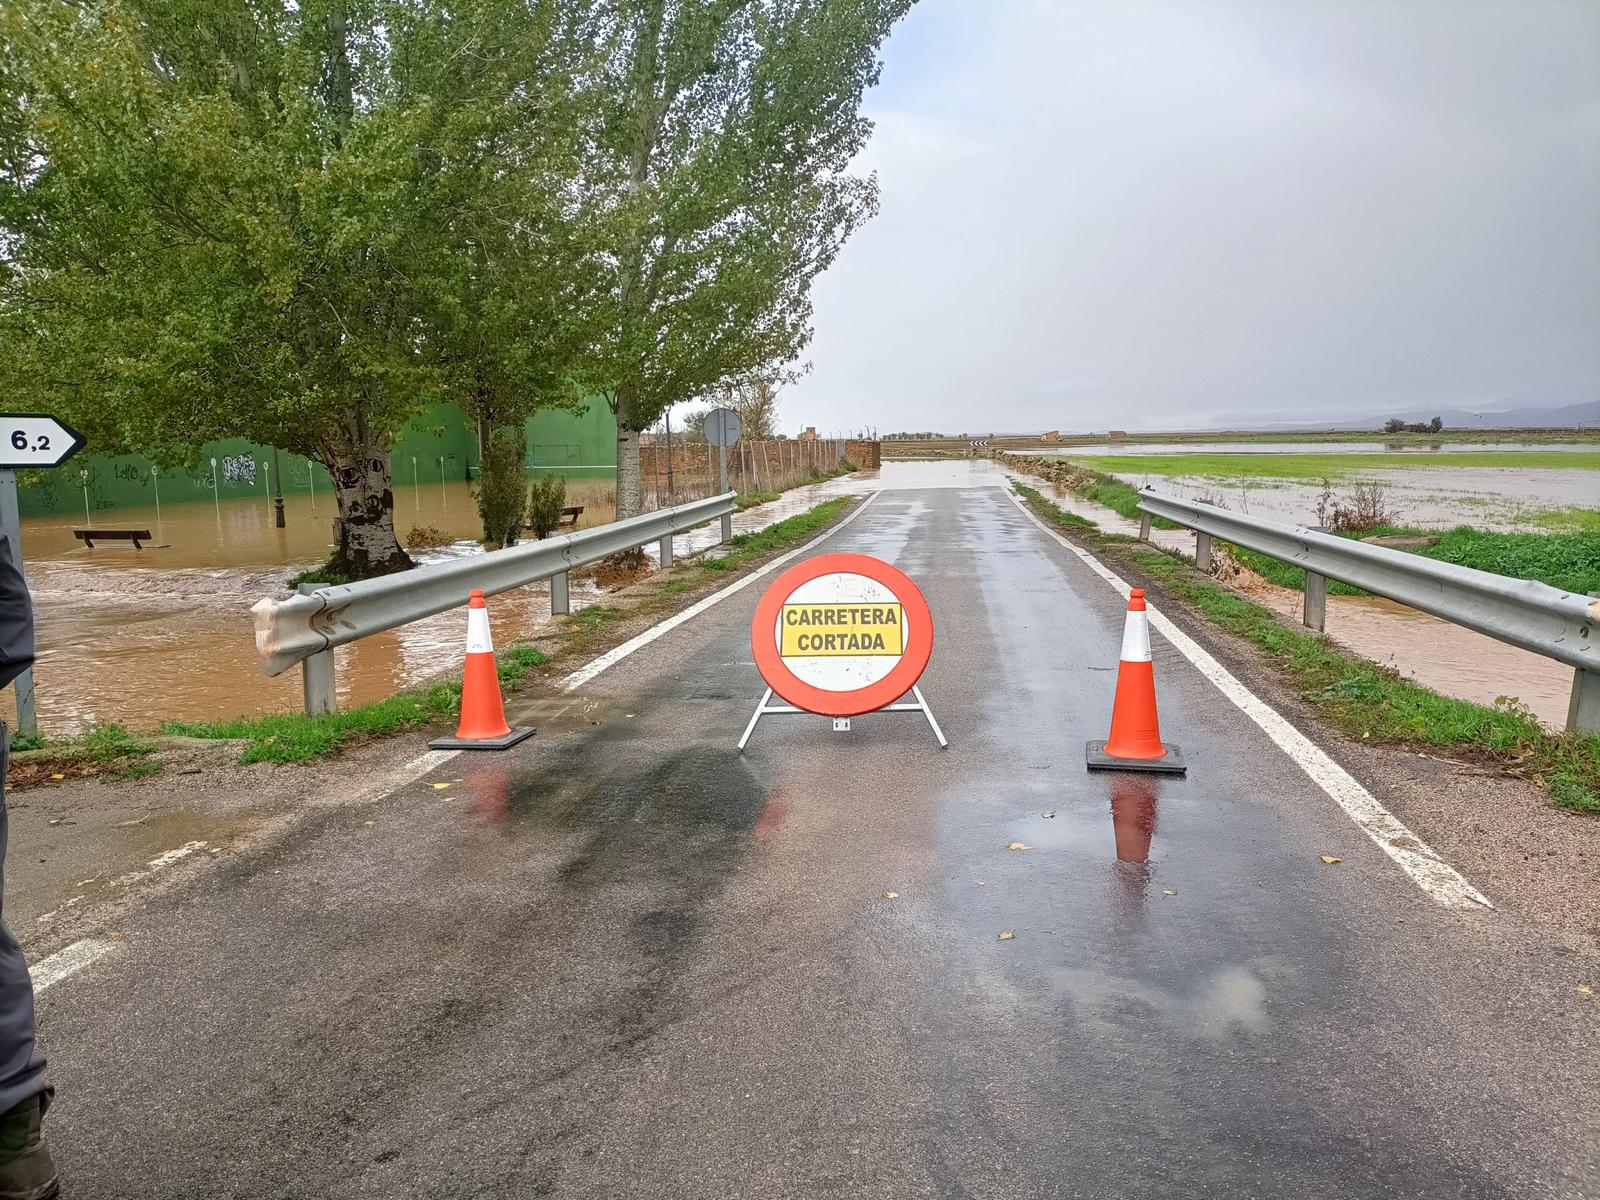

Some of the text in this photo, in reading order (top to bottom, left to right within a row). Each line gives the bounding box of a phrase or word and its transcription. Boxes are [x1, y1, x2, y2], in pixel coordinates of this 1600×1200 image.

[11, 430, 50, 452] 6,2
[786, 608, 897, 626] CARRETERA
[797, 633, 885, 651] CORTADA
